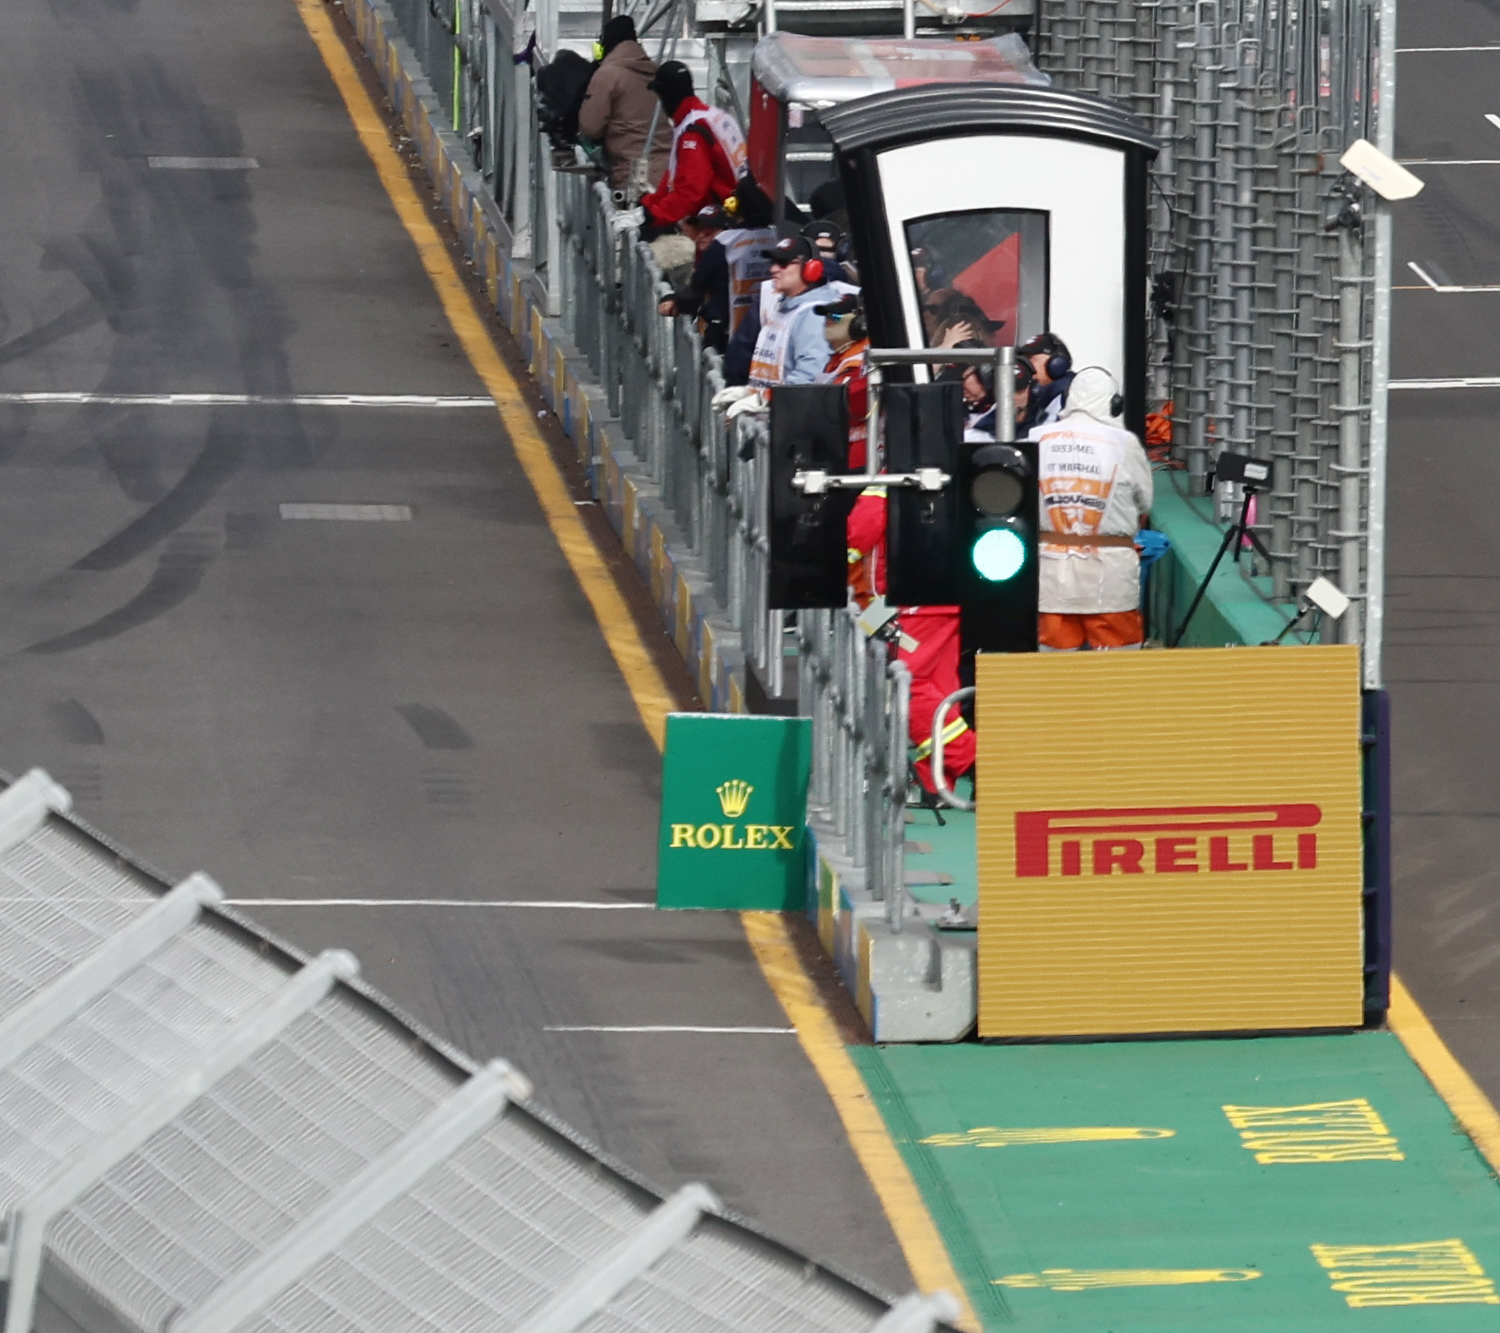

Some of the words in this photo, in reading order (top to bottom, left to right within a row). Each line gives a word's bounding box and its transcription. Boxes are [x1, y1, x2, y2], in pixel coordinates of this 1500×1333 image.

[670, 823, 796, 851] ROLEX
[1014, 803, 1323, 878] PIRELLI
[1222, 1097, 1404, 1165] ROLEX
